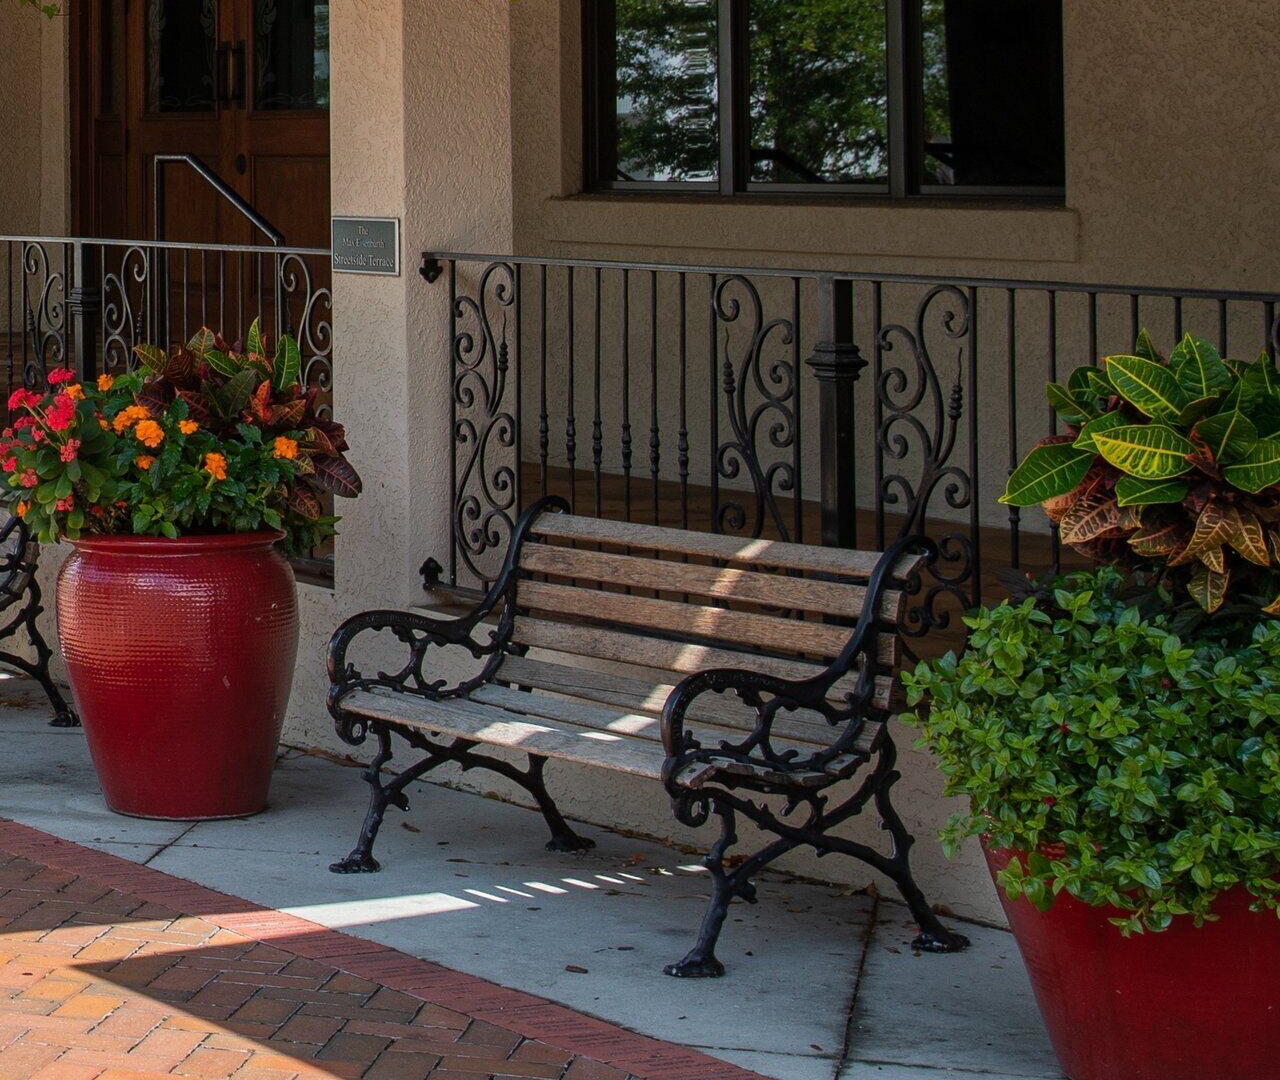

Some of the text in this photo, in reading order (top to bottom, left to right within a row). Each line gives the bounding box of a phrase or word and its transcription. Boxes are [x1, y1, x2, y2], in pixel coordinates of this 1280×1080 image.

[357, 225, 369, 235] The
[334, 252, 394, 268] Streetside Terrace
